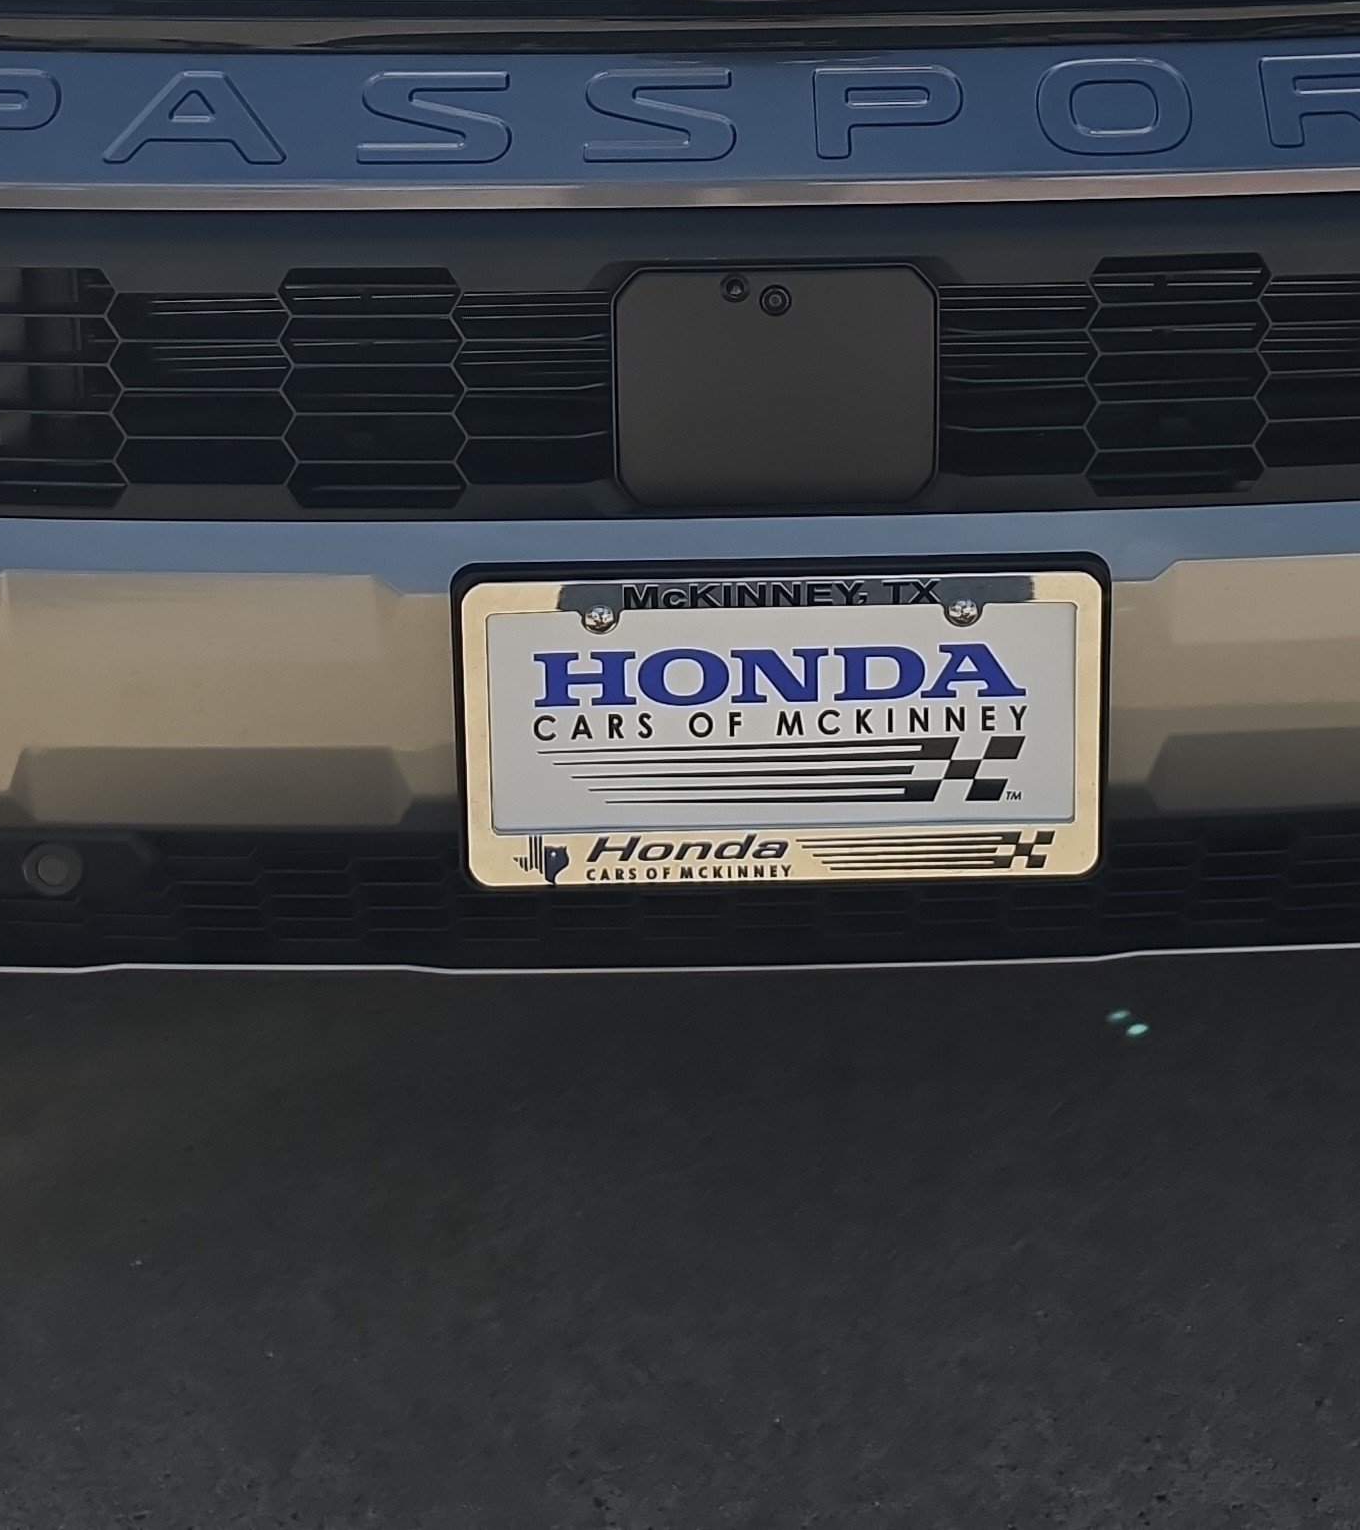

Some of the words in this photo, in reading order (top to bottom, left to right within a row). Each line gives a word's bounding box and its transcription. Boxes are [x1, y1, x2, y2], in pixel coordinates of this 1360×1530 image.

[621, 580, 868, 609] McKINNEY,
[881, 579, 941, 605] TX
[533, 643, 1027, 707] HONDA
[533, 712, 654, 741] CARS
[688, 711, 743, 738] OF
[777, 705, 1029, 736] MCKINNEY
[1005, 790, 1023, 801] TM
[586, 833, 790, 863] Honda
[586, 867, 637, 881] CARS
[646, 866, 671, 880] OF
[679, 864, 792, 880] MCKINNEY
